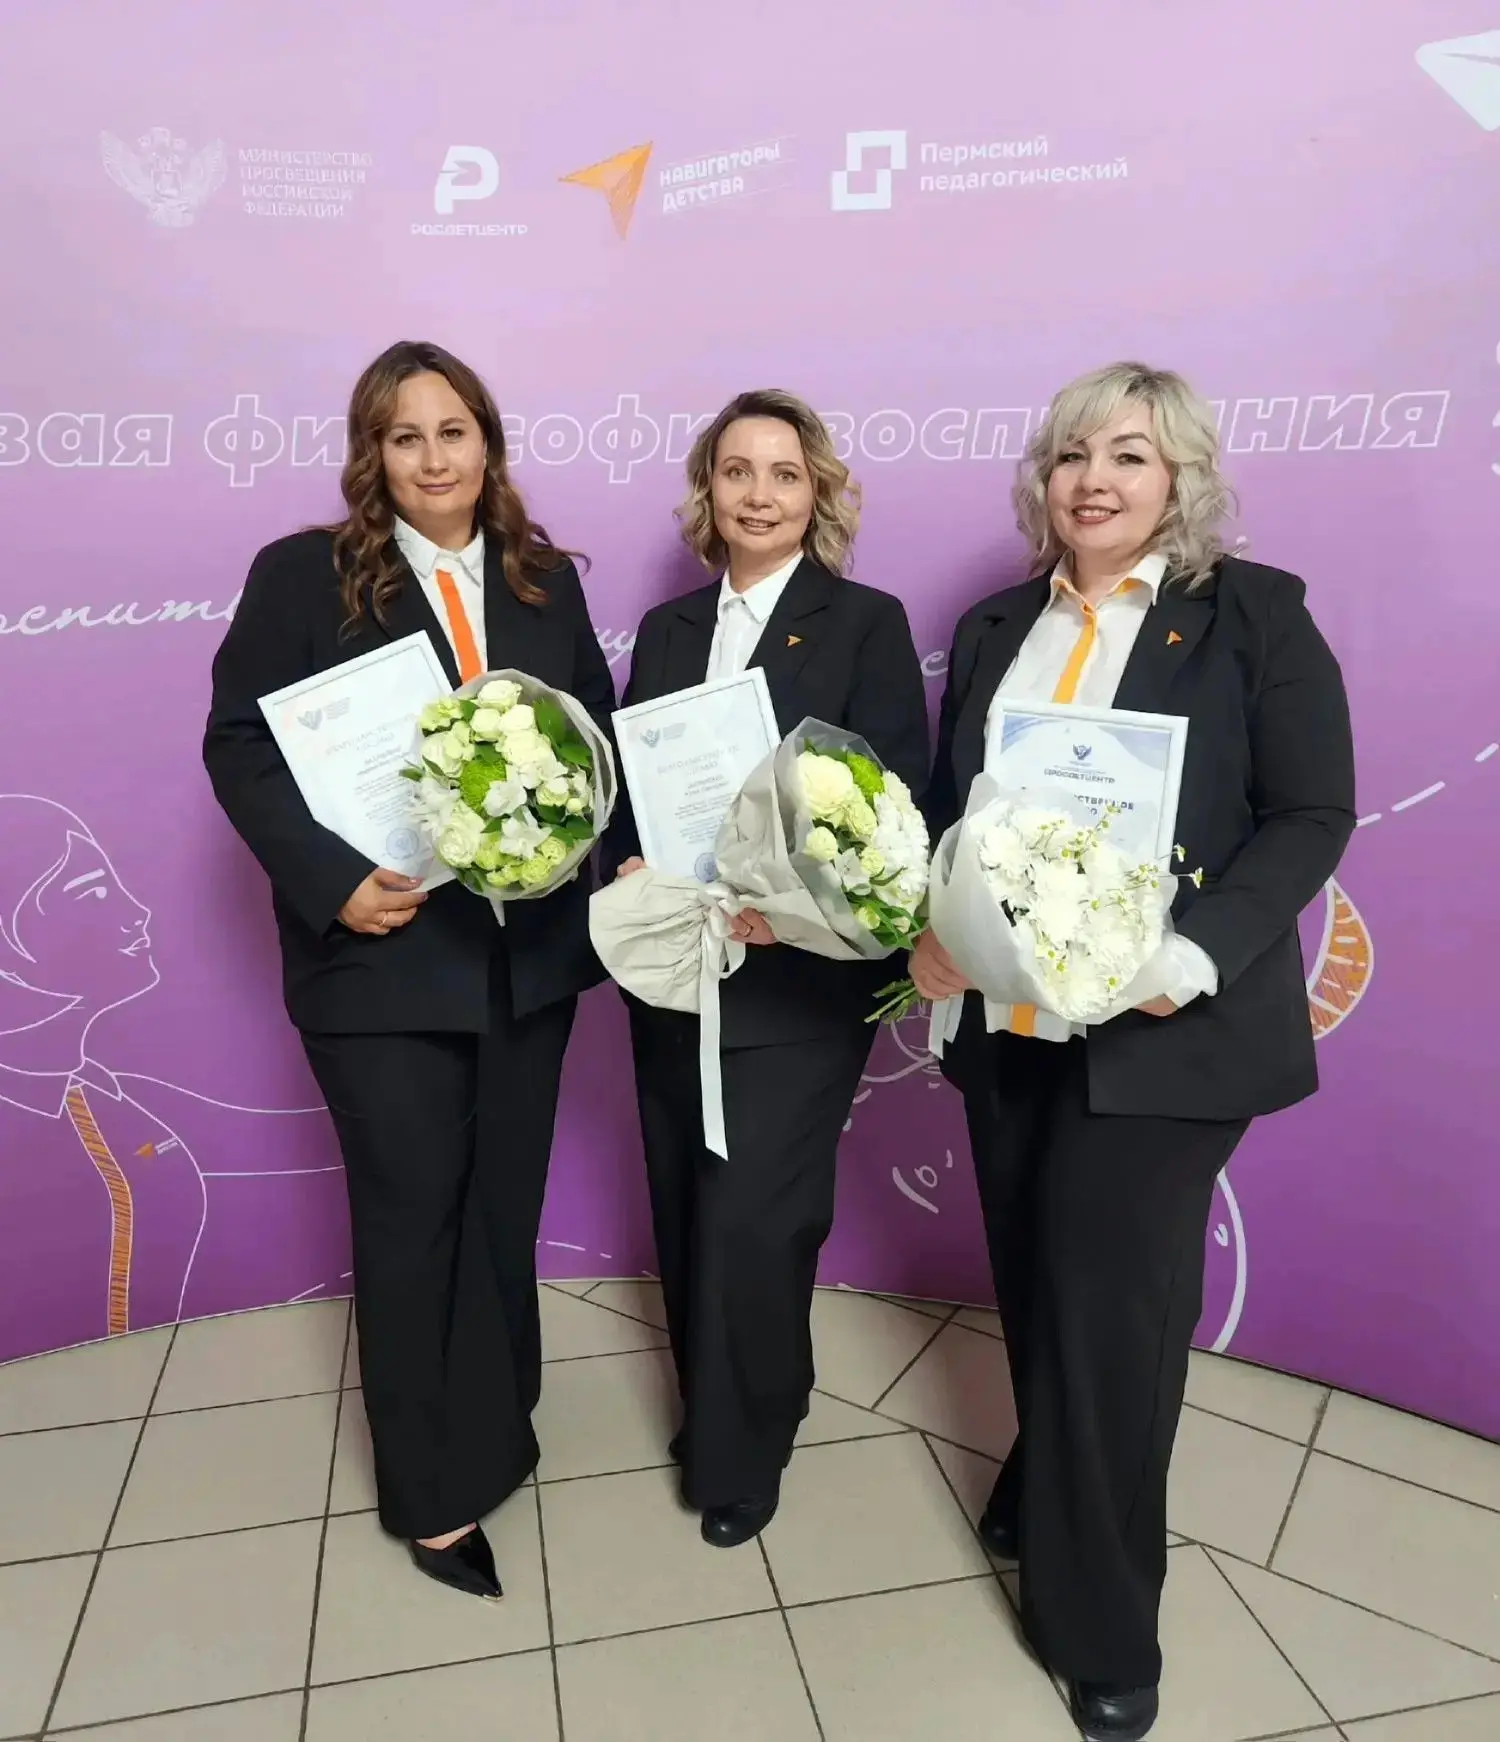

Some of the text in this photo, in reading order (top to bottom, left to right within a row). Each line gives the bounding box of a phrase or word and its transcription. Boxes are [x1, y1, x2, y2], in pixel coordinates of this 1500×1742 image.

[239, 148, 372, 166] МИНИСТЕРСТВО
[920, 136, 1048, 166] Пермский
[660, 141, 781, 187] НАВИГАТОРЫ
[240, 166, 366, 183] ПРОСВЕЩЕНИЯ
[920, 157, 1129, 192] педагогический
[242, 184, 353, 201] РОССИЙСКОЙ
[662, 176, 744, 213] ДЕТСТВА
[244, 201, 345, 217] ФЕДЕРАЦИИ
[410, 223, 529, 237] РОСДЕТЦЕНТР
